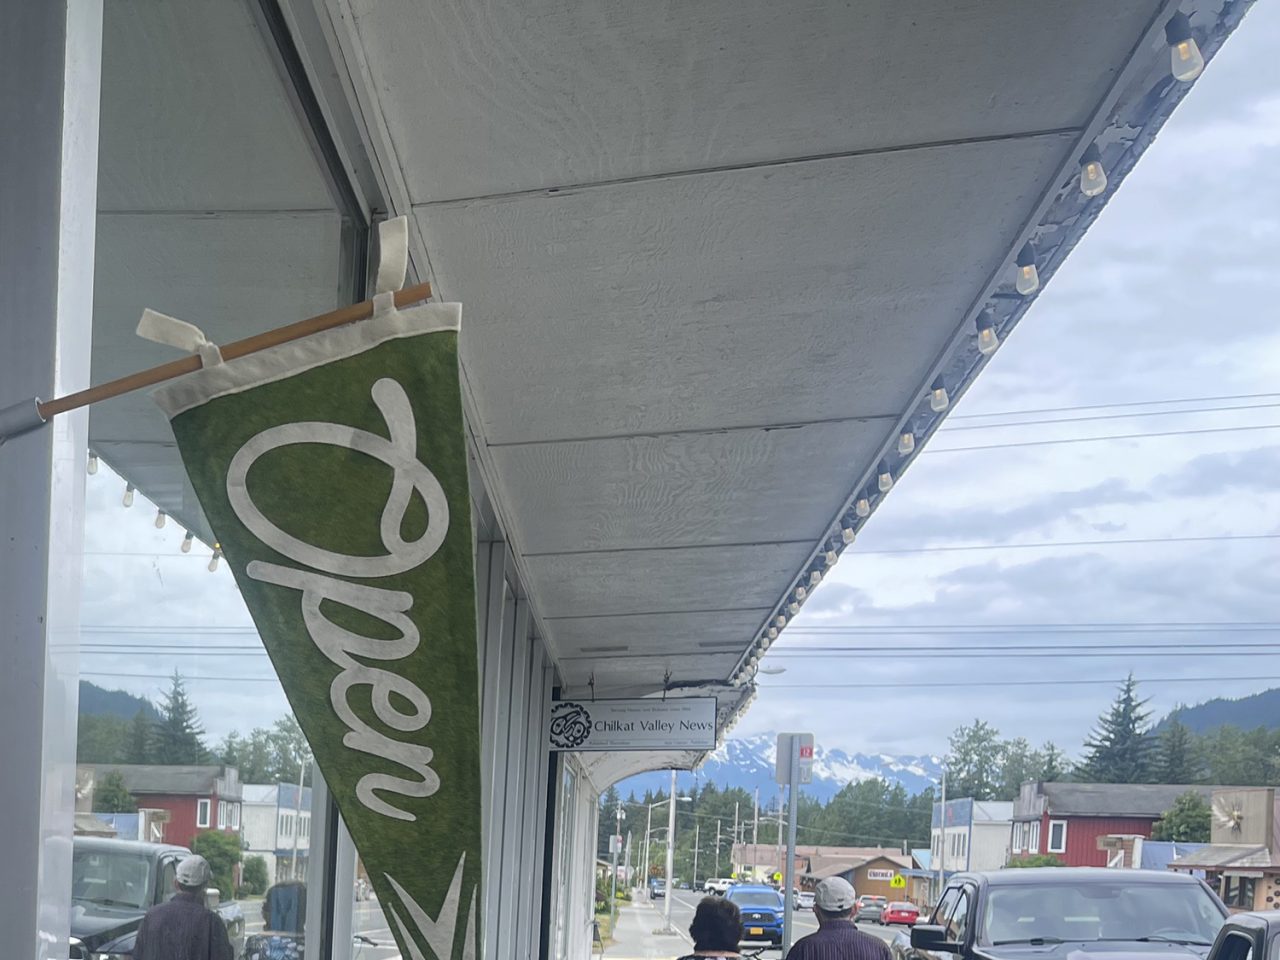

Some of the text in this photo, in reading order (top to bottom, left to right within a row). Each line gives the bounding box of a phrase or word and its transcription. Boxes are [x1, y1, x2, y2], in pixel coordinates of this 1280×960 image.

[226, 376, 450, 822] Open
[594, 720, 714, 733] Chilkat Valley News
